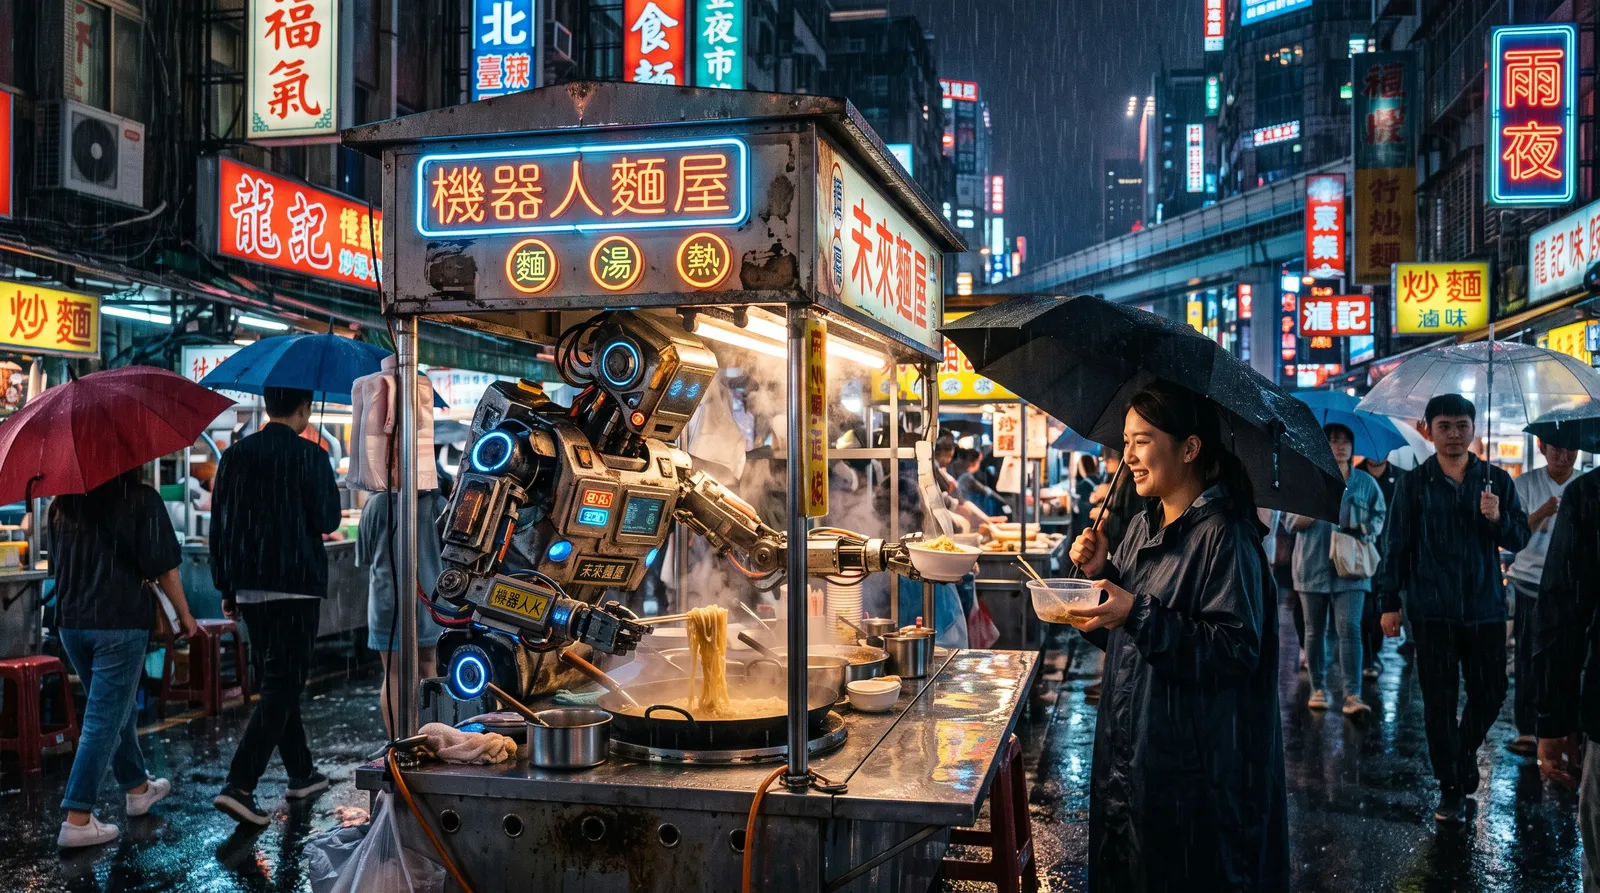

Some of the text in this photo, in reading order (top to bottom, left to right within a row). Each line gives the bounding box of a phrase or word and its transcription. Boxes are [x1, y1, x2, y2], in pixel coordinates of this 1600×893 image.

[481, 1, 527, 46] 北
[703, 0, 738, 89] 夜市
[264, 0, 322, 120] 福氣
[1503, 49, 1563, 181] 雨夜
[230, 173, 332, 270] 龍記
[431, 153, 730, 225] 機器人麵屋
[516, 242, 720, 282] 麵 湯 熱
[852, 198, 927, 329] 未來麵屋
[1403, 269, 1482, 303] 炒麵
[9, 290, 92, 347] 炒麵
[1417, 308, 1468, 328] 滷味
